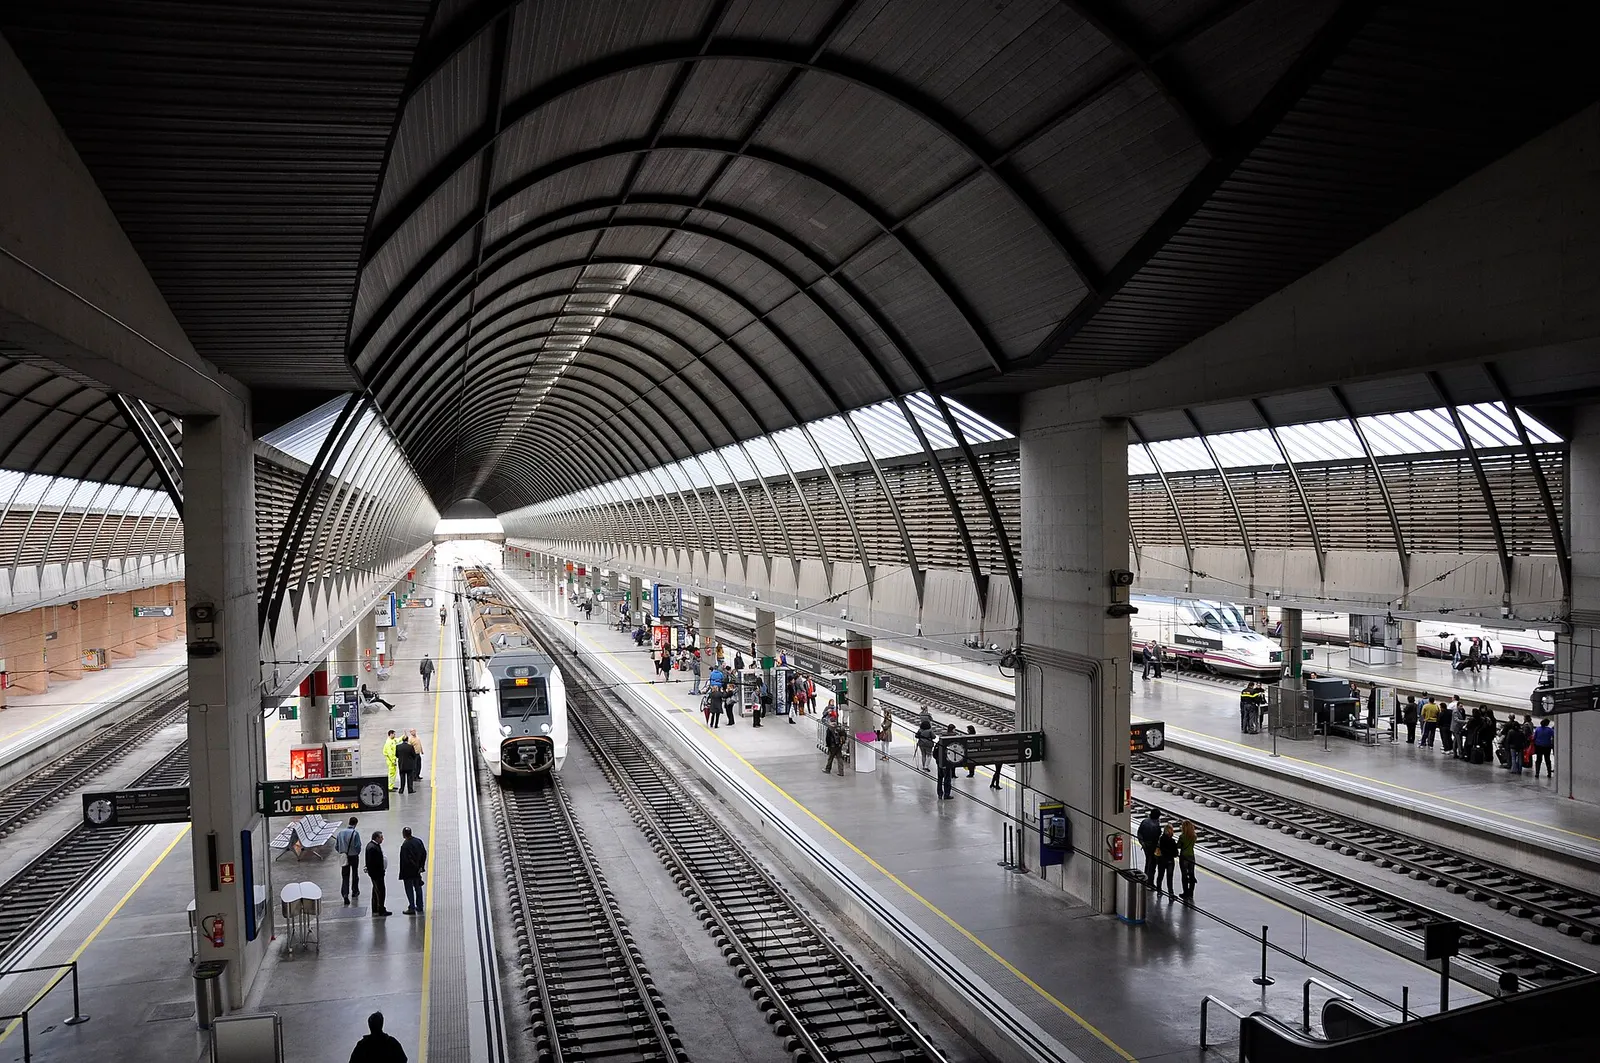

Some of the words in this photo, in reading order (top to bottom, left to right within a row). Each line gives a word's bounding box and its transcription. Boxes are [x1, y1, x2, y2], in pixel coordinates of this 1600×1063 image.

[1284, 667, 1290, 676] A
[1592, 697, 1598, 708] 7
[1024, 748, 1032, 759] 9
[274, 799, 291, 813] 10
